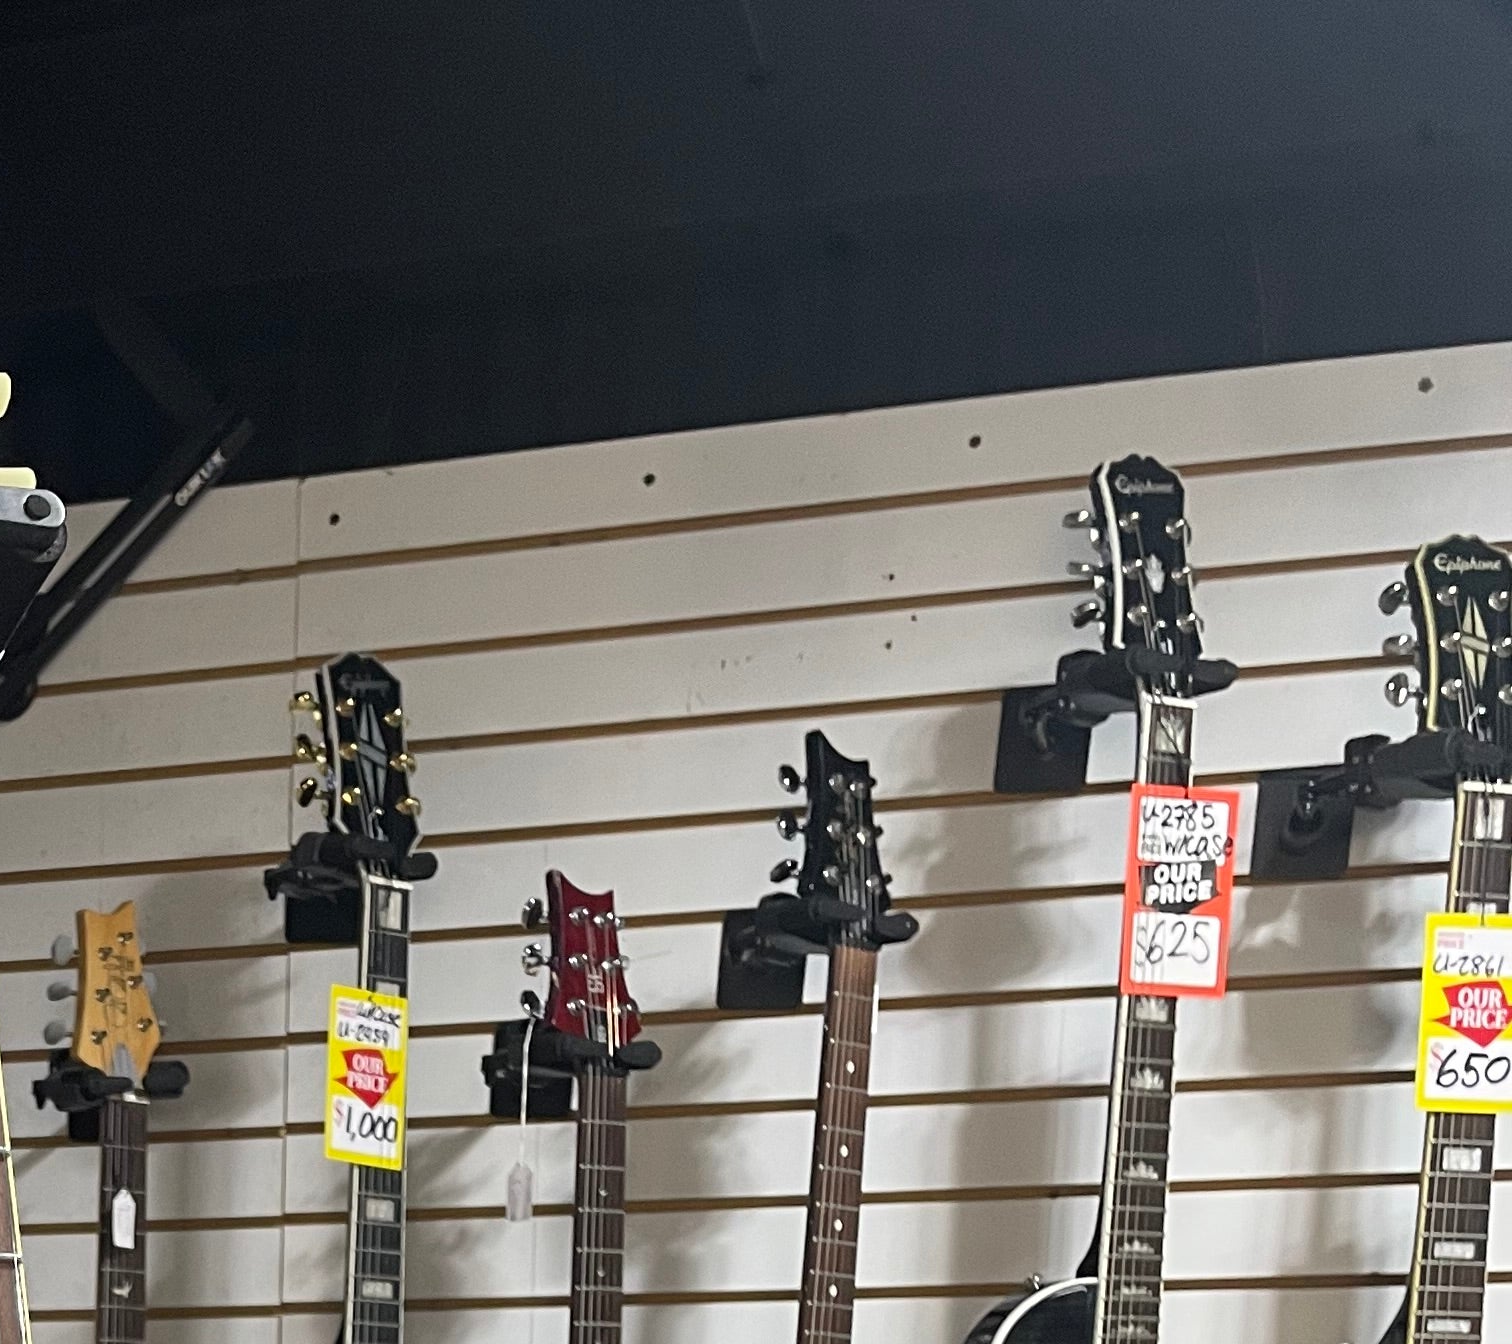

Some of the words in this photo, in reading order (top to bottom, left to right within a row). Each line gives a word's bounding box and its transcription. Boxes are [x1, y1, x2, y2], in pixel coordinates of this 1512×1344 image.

[1153, 862, 1203, 884] OUR
[1145, 879, 1214, 906] PRICE
[1457, 986, 1503, 1009] OUR
[1449, 1006, 1508, 1030] PRICE
[351, 1053, 385, 1076] OUR
[346, 1070, 389, 1094] PRICE
